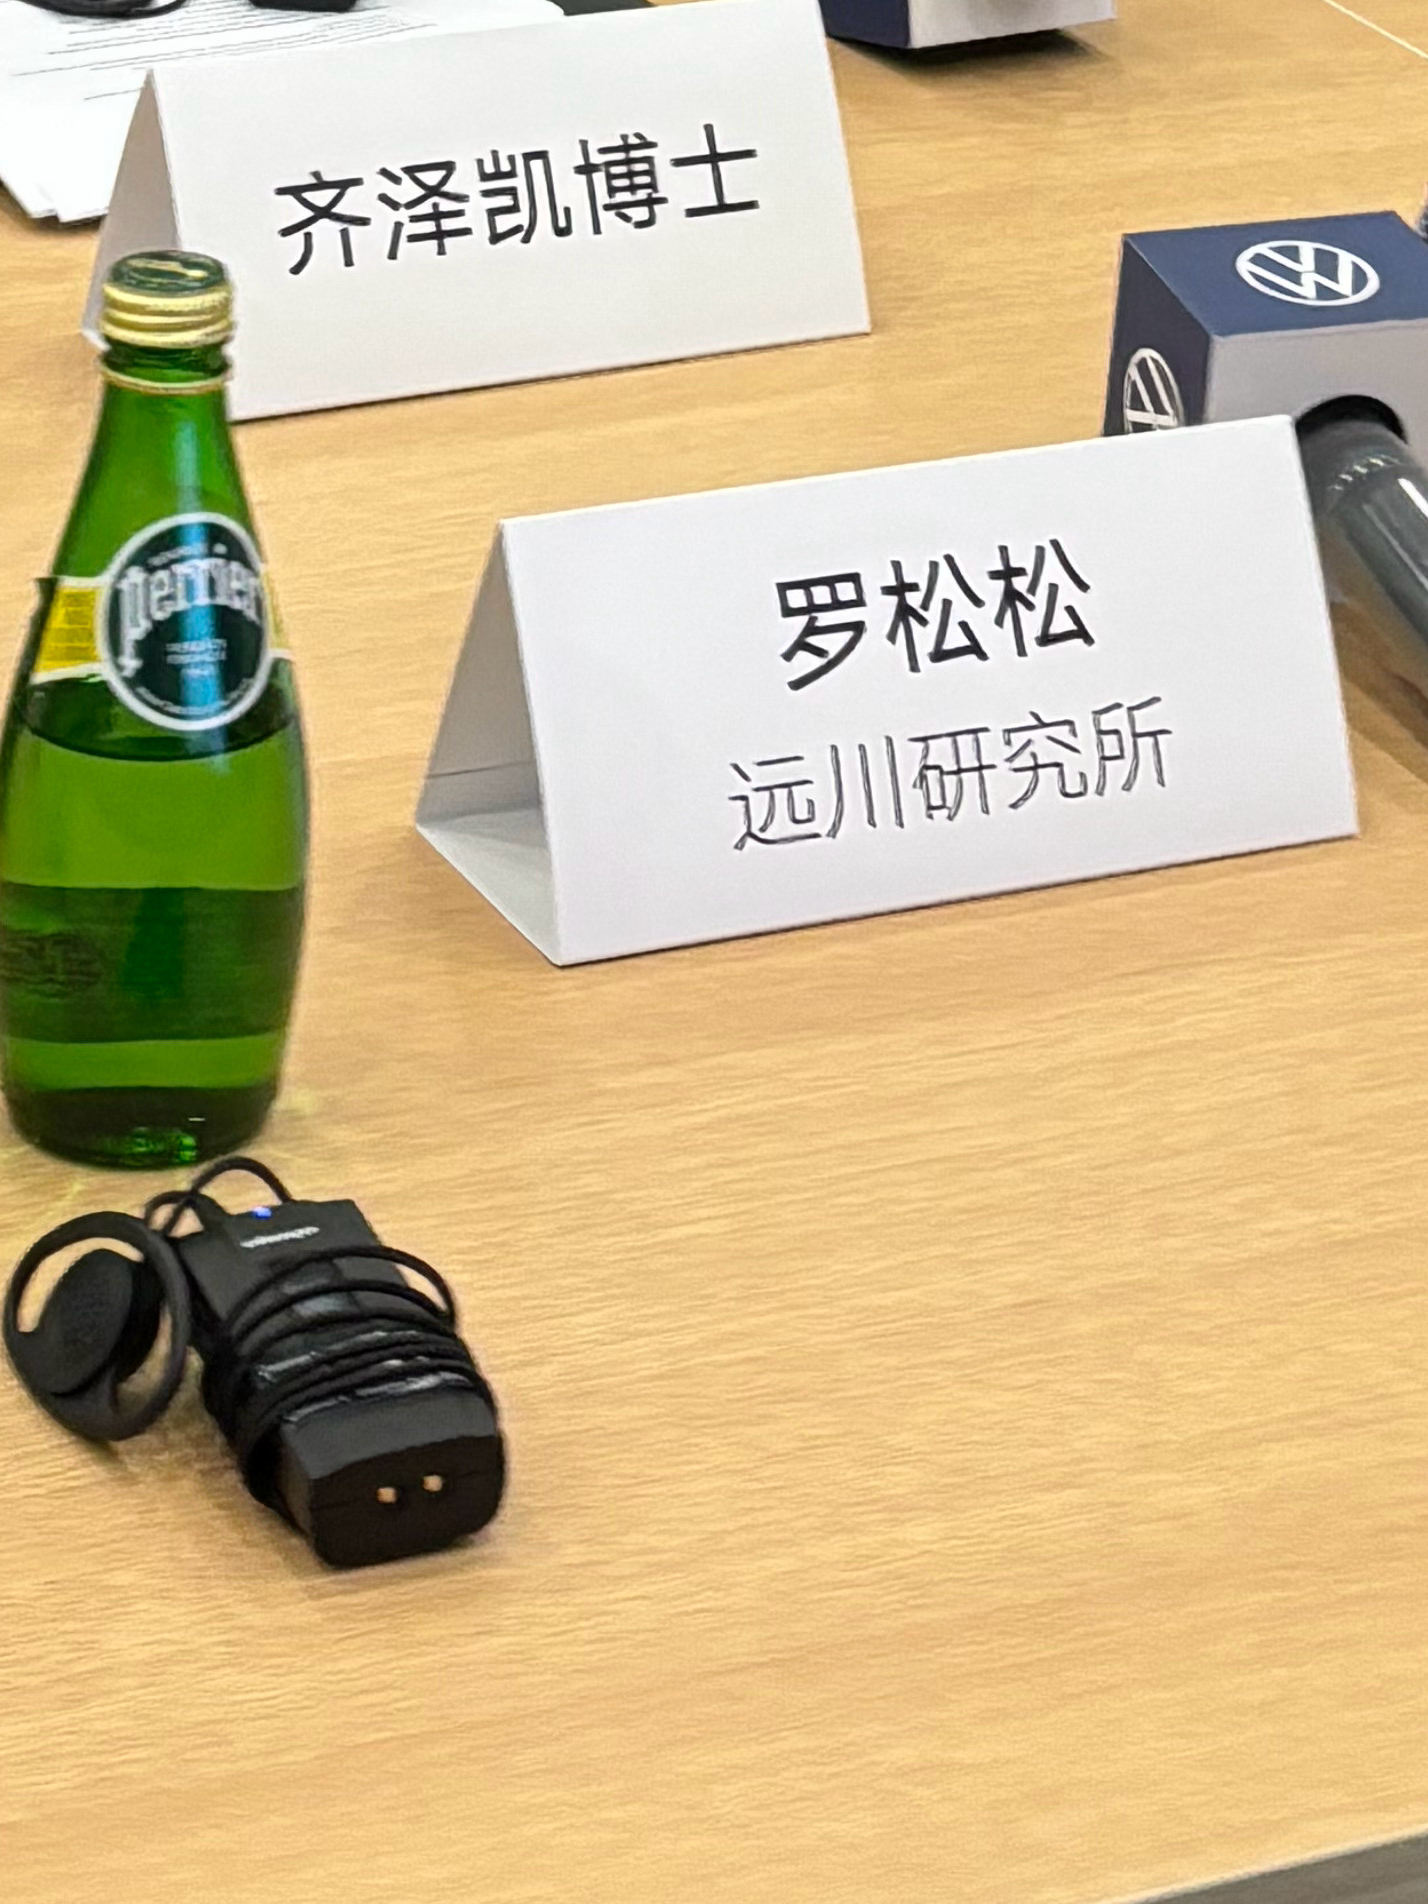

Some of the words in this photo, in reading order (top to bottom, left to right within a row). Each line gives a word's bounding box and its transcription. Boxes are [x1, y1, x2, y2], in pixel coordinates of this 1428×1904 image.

[276, 125, 759, 276] 齐泽凯博士
[116, 556, 260, 677] Perrier
[777, 540, 1095, 691] 罗松松
[731, 698, 1172, 851] 远川研究所
